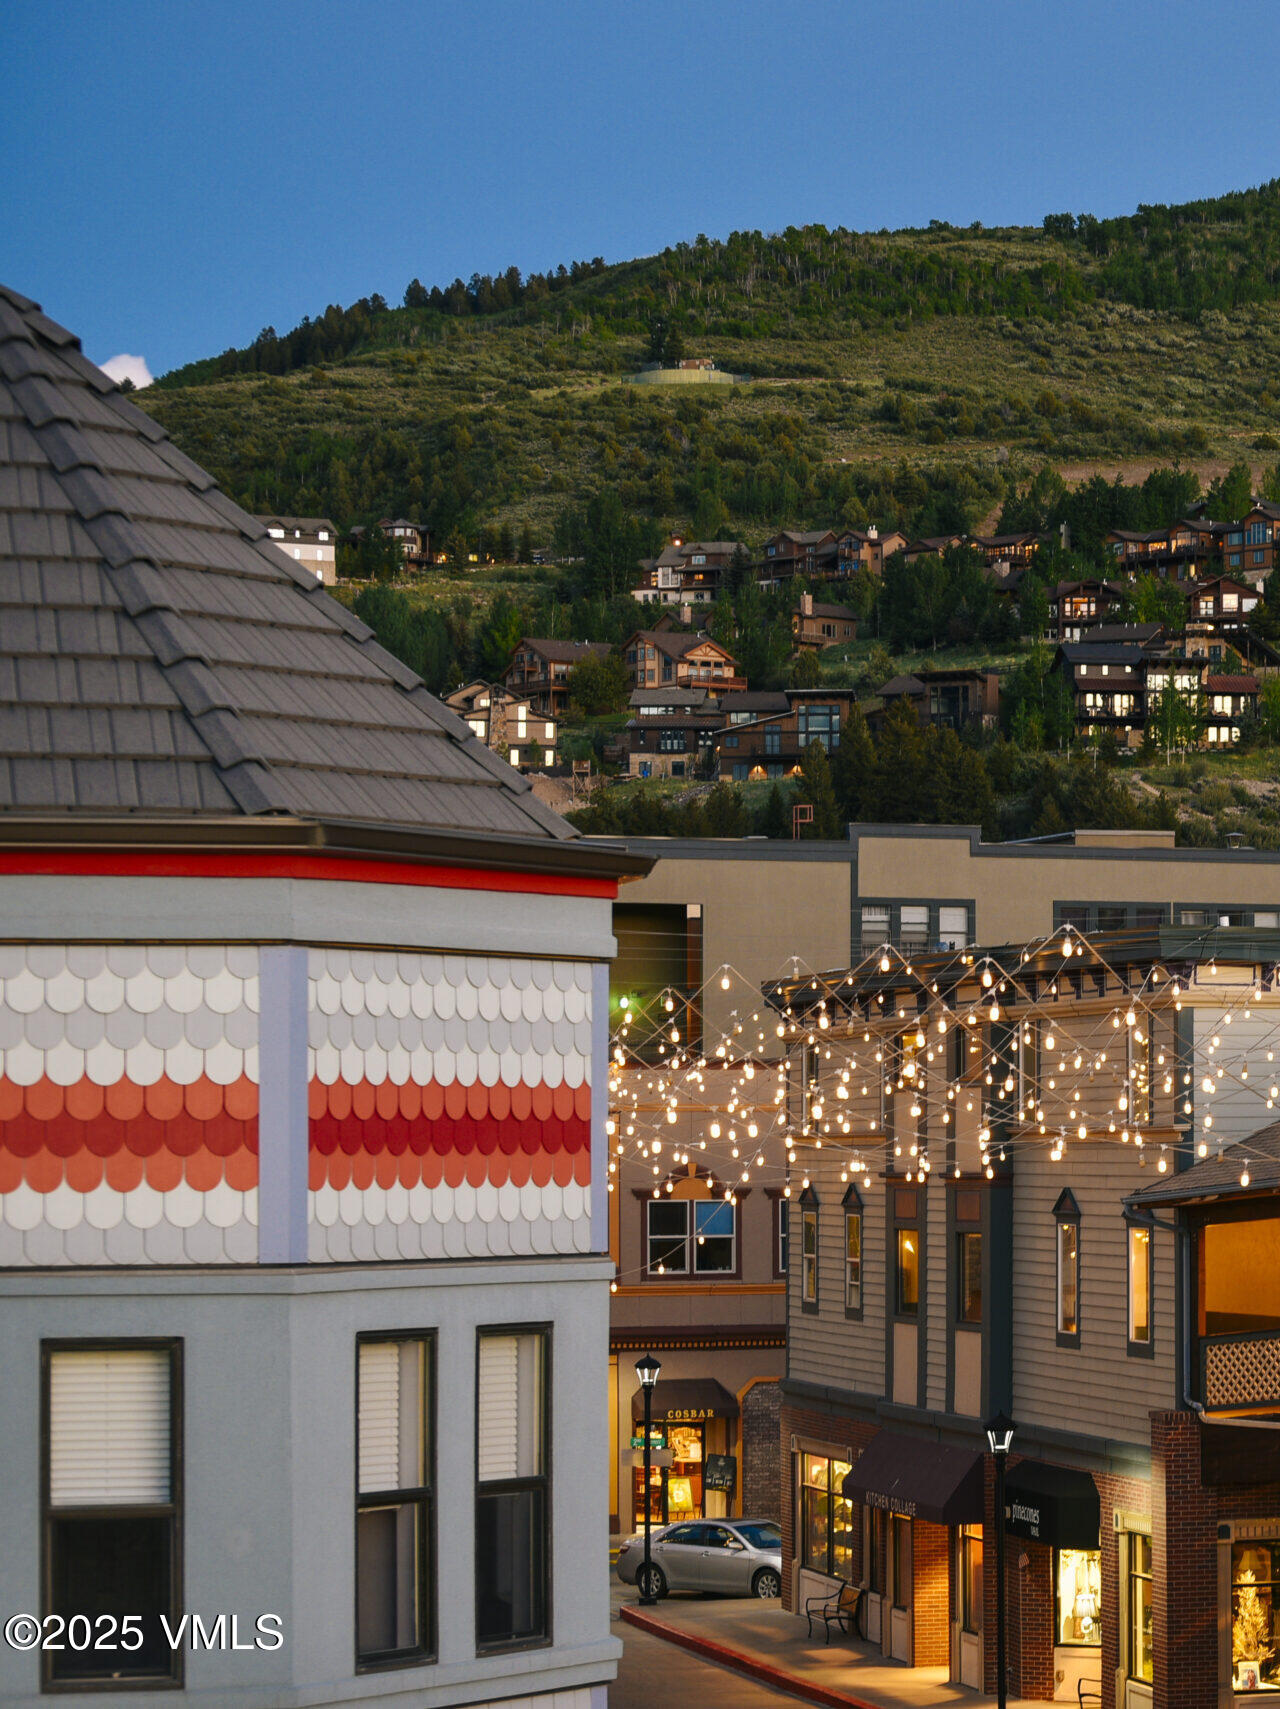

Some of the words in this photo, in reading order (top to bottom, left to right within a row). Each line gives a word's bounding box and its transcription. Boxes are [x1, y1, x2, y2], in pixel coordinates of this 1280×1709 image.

[667, 1409, 714, 1419] COSBAR
[865, 1490, 889, 1509] KITCHEN
[890, 1496, 916, 1517] COLLAGE
